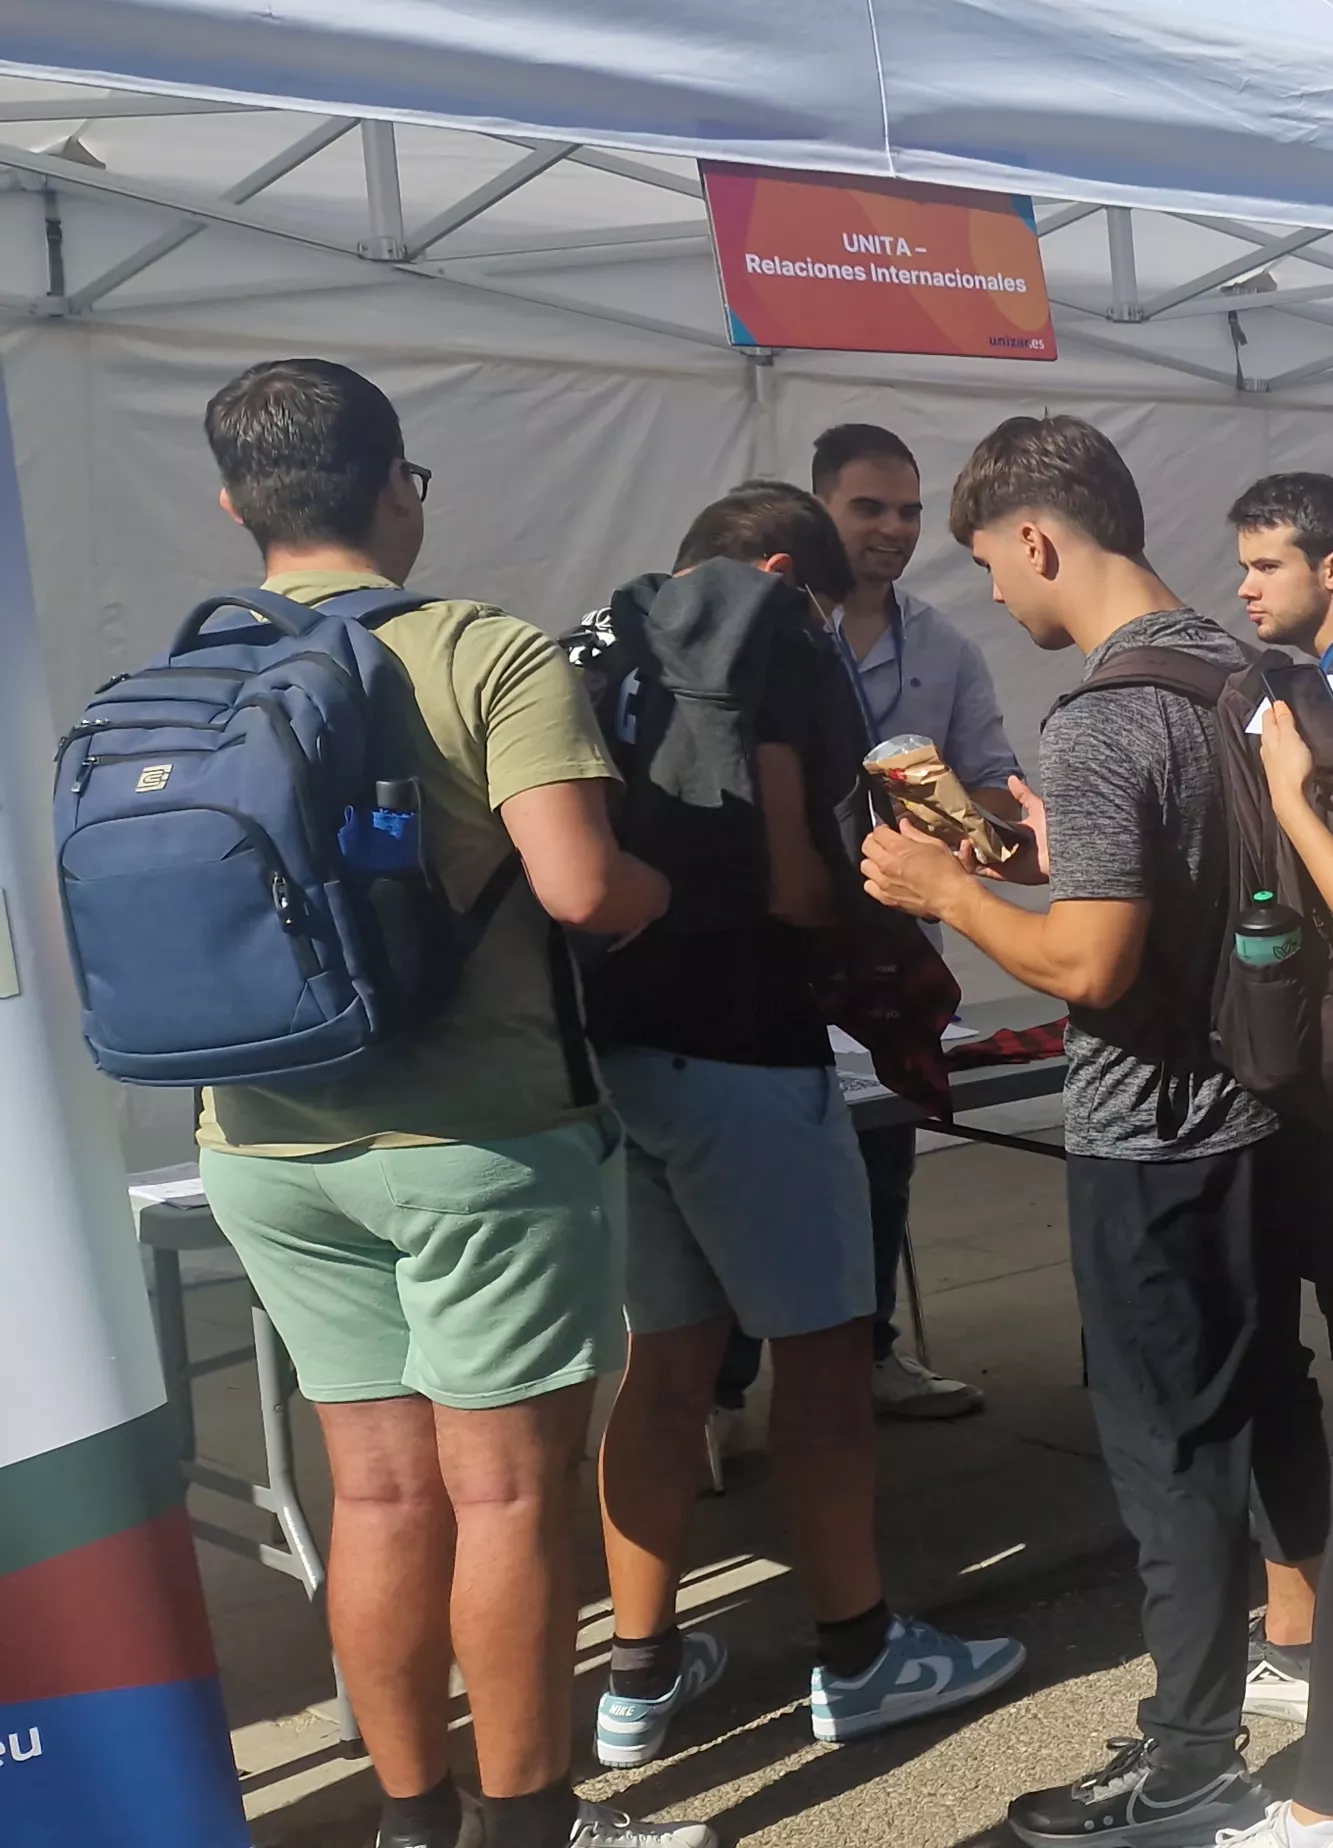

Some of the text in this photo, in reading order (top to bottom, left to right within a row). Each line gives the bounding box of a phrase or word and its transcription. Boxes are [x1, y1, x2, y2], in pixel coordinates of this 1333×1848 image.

[842, 233, 912, 257] UNITA
[745, 253, 1027, 293] Relaciones Internacionales
[989, 335, 1045, 351] unizar.es
[608, 1703, 636, 1717] NIKE
[0, 1726, 42, 1767] u
